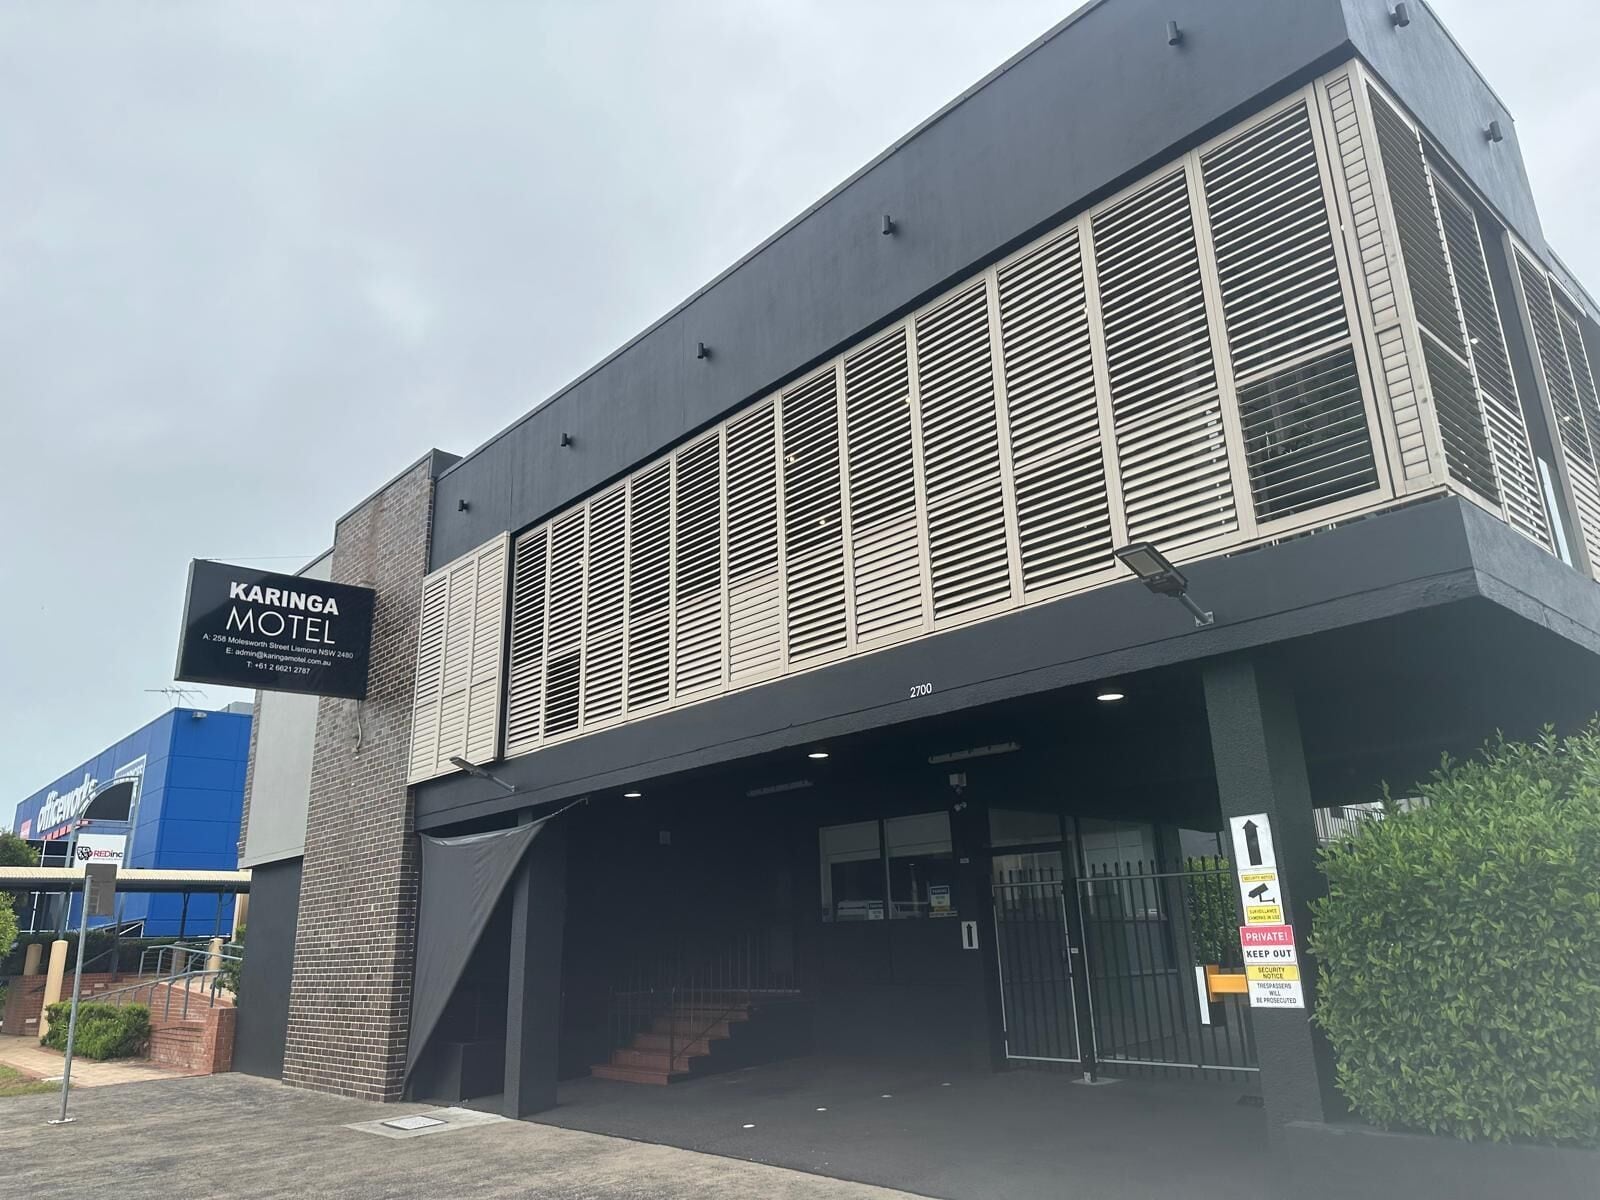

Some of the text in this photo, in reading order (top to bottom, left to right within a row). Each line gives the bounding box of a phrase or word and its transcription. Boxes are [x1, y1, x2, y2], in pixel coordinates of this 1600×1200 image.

[229, 581, 339, 616] KARINGA
[225, 605, 336, 644] MOTEL
[202, 633, 354, 659] A: 258 Molesworth Street Lismore NSW 2480
[225, 647, 332, 666] E: admin@karingamotel.com.au
[255, 662, 267, 670] +61
[269, 663, 274, 671] 2
[275, 664, 292, 672] 6621
[293, 666, 311, 675] 2787
[910, 682, 933, 698] 2700
[1245, 931, 1288, 942] PRIVATE!
[1246, 949, 1292, 958] KEEP OUT
